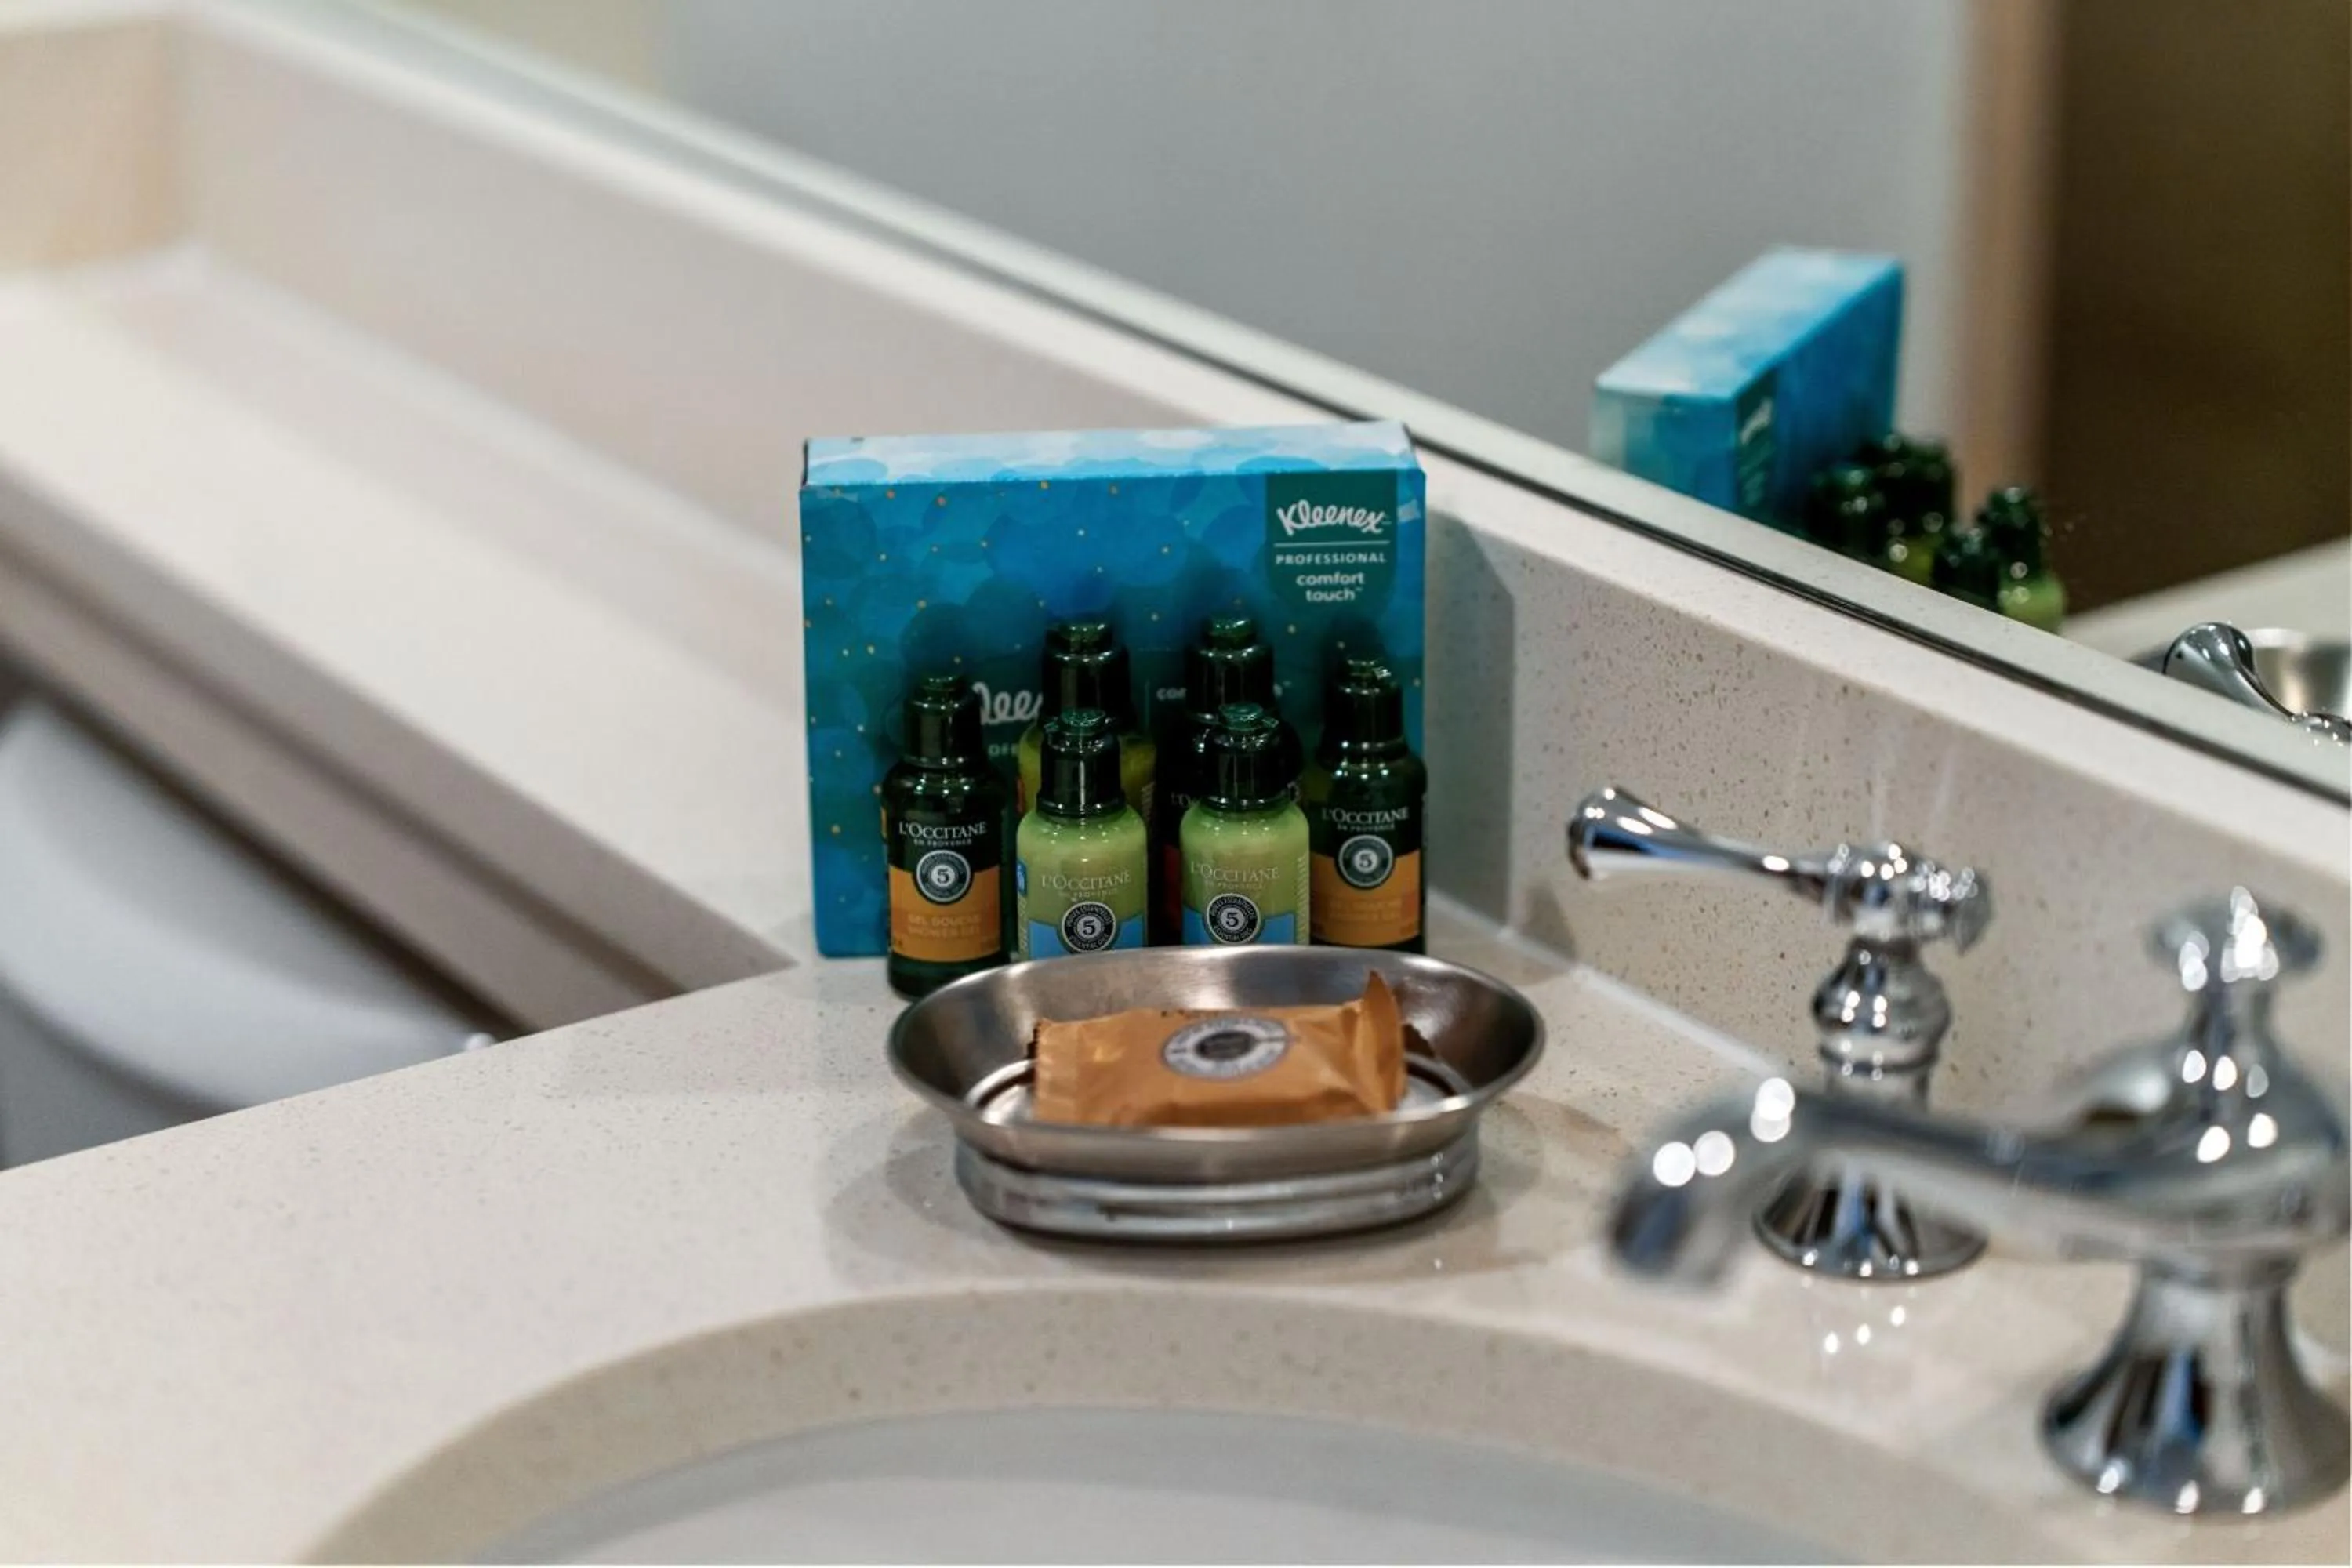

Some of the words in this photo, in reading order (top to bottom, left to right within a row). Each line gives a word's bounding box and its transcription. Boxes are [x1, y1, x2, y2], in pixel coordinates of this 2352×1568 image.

[1277, 499, 1385, 535] Kleenex
[1276, 553, 1387, 564] PROFESSIONAL
[1296, 572, 1365, 586] comfort
[1322, 807, 1409, 823] L'OCCITANE
[898, 822, 987, 839] L'OCCITANE
[1359, 853, 1372, 869] 5
[937, 868, 949, 884] 5
[1083, 919, 1096, 935] 5
[1225, 912, 1239, 927] 5
